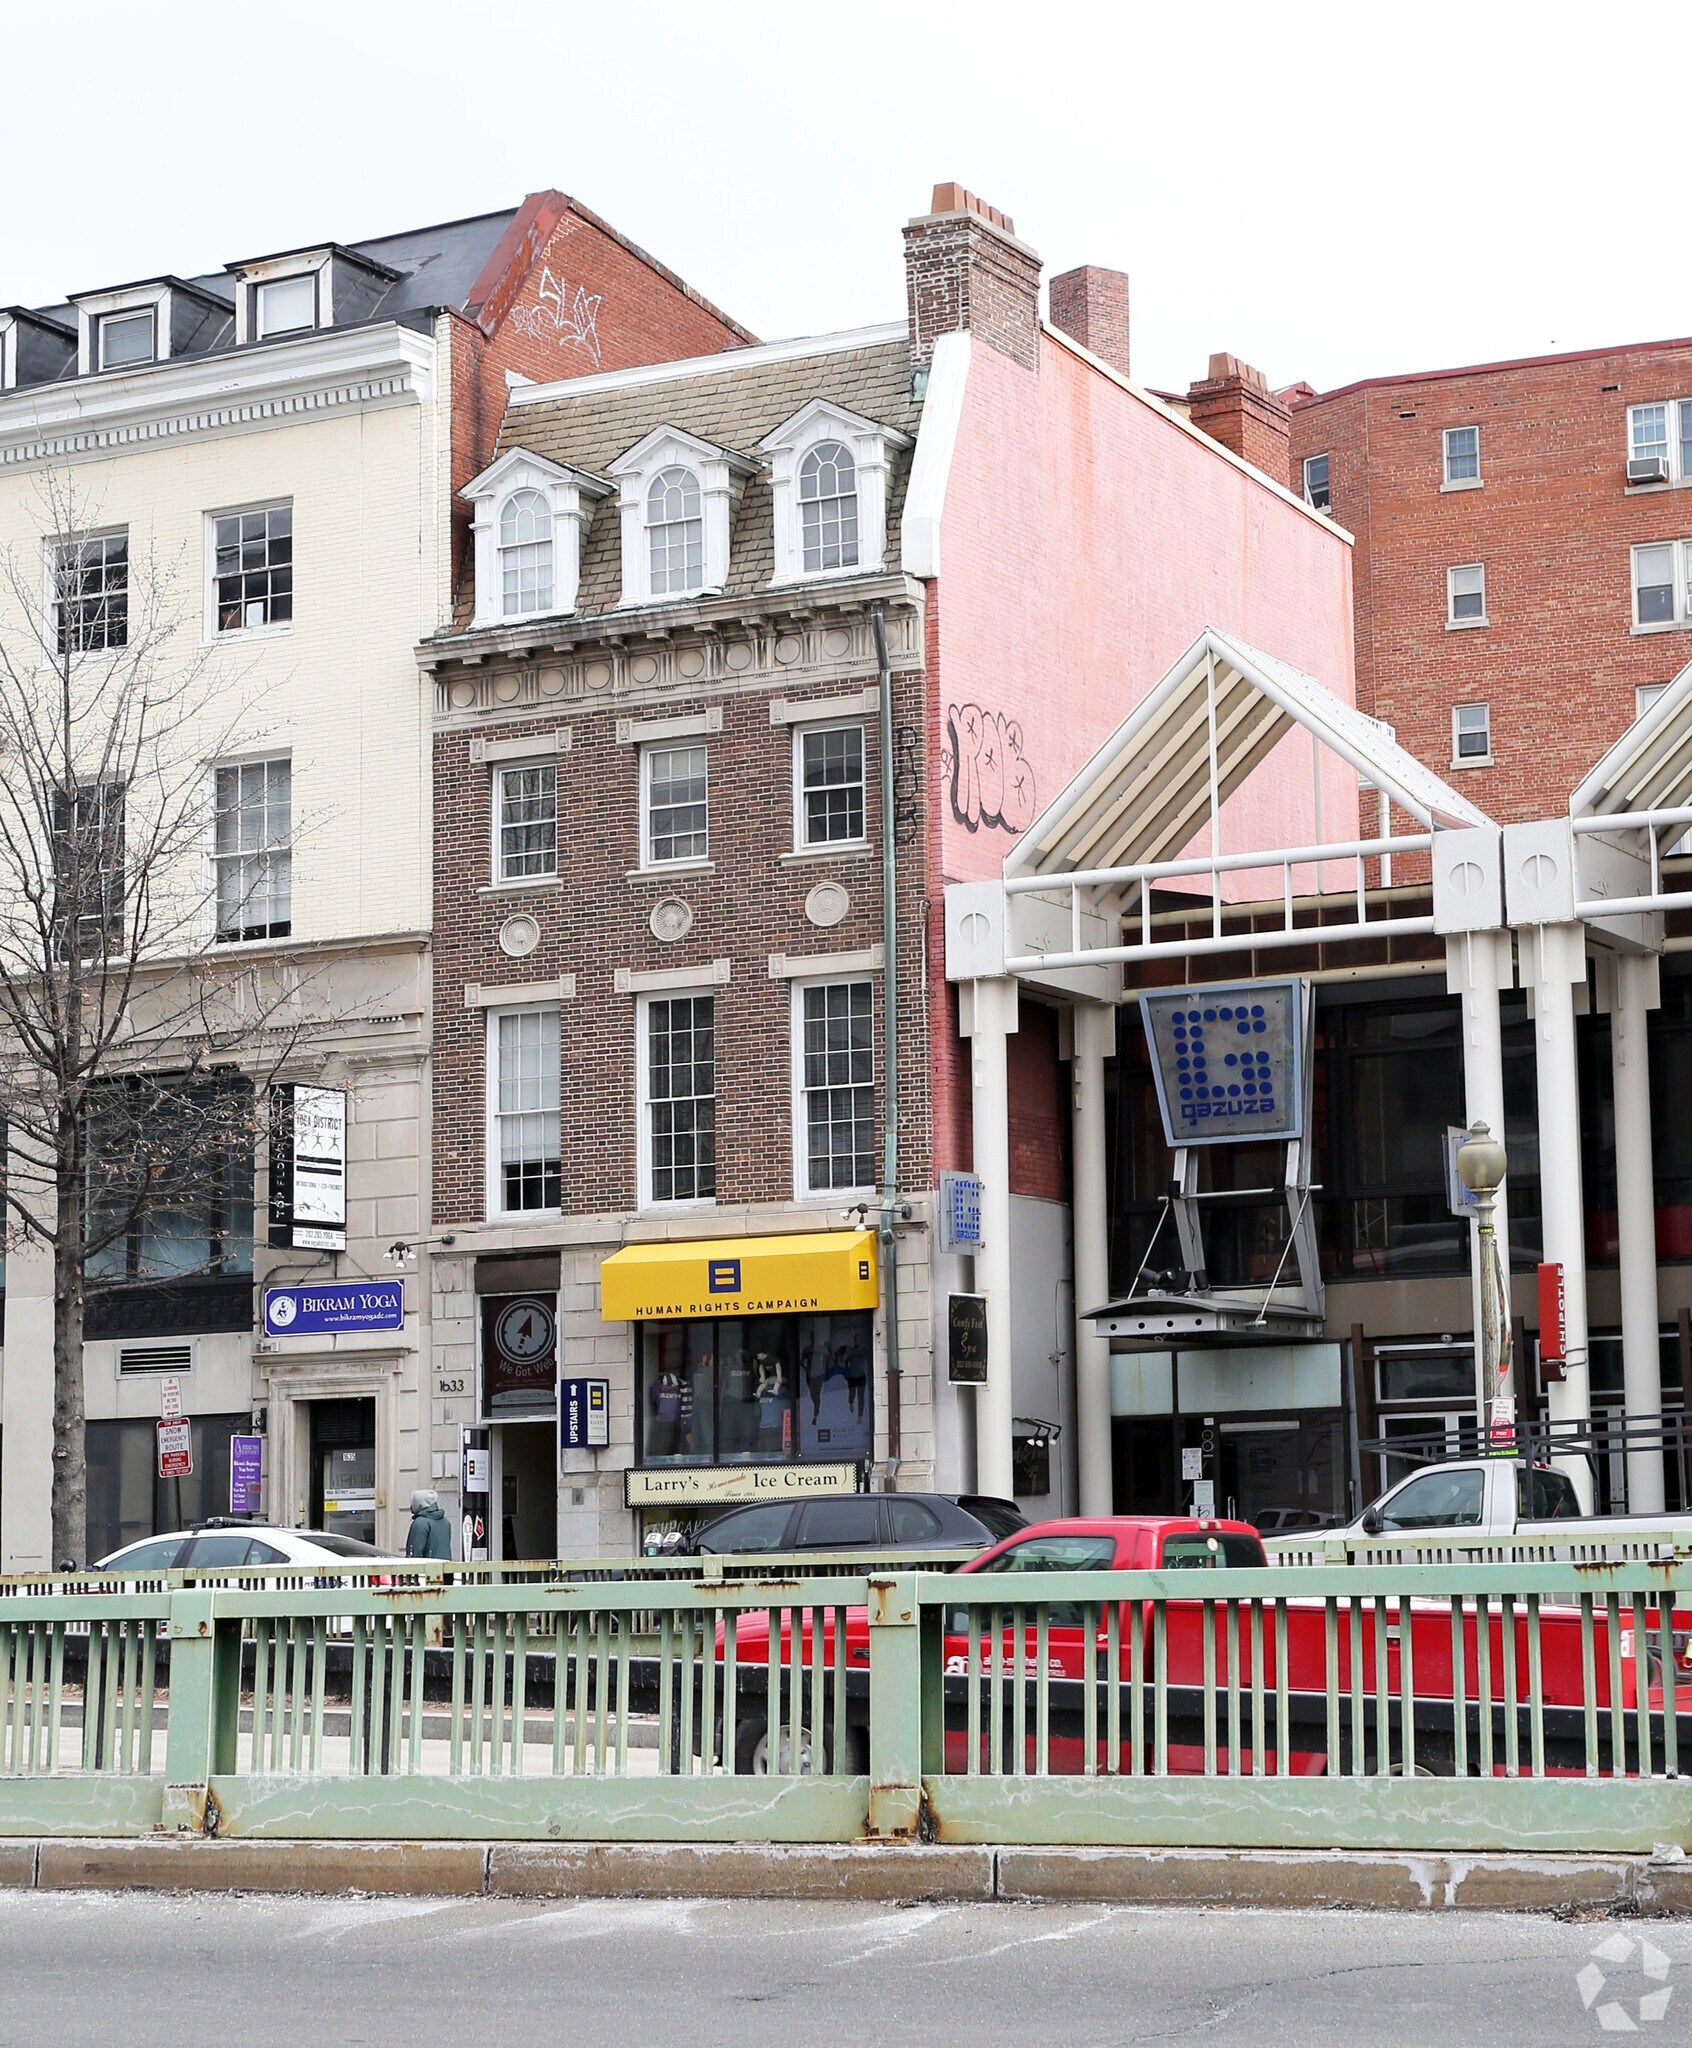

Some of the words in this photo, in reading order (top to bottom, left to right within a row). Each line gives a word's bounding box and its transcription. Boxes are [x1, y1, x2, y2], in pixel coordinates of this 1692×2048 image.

[1181, 1098, 1275, 1126] gazuza
[314, 1115, 342, 1131] DISTRICT
[302, 1297, 355, 1313] BIKRAM
[359, 1293, 398, 1309] YOGA
[635, 1304, 683, 1316] HUMAN
[689, 1301, 740, 1313] RIGHTS
[747, 1298, 819, 1310] CAMPAIGN
[1557, 1266, 1566, 1355] CHIPOTLE
[324, 1312, 398, 1323] www.bikramyogadc.com
[498, 1358, 513, 1375] We
[515, 1366, 533, 1377] Got
[533, 1356, 555, 1375] Web
[439, 1379, 465, 1392] 1633
[569, 1400, 579, 1443] UPSTAIRS
[161, 1435, 187, 1443] EMERGENCY
[165, 1427, 182, 1435] SNOW
[165, 1443, 184, 1451] ROUTE
[643, 1476, 700, 1493] Larry's
[706, 1472, 747, 1491] Homemade
[753, 1473, 778, 1488] Ice
[784, 1471, 838, 1487] Cream
[723, 1490, 742, 1498] Since
[648, 1547, 655, 1555] 2
